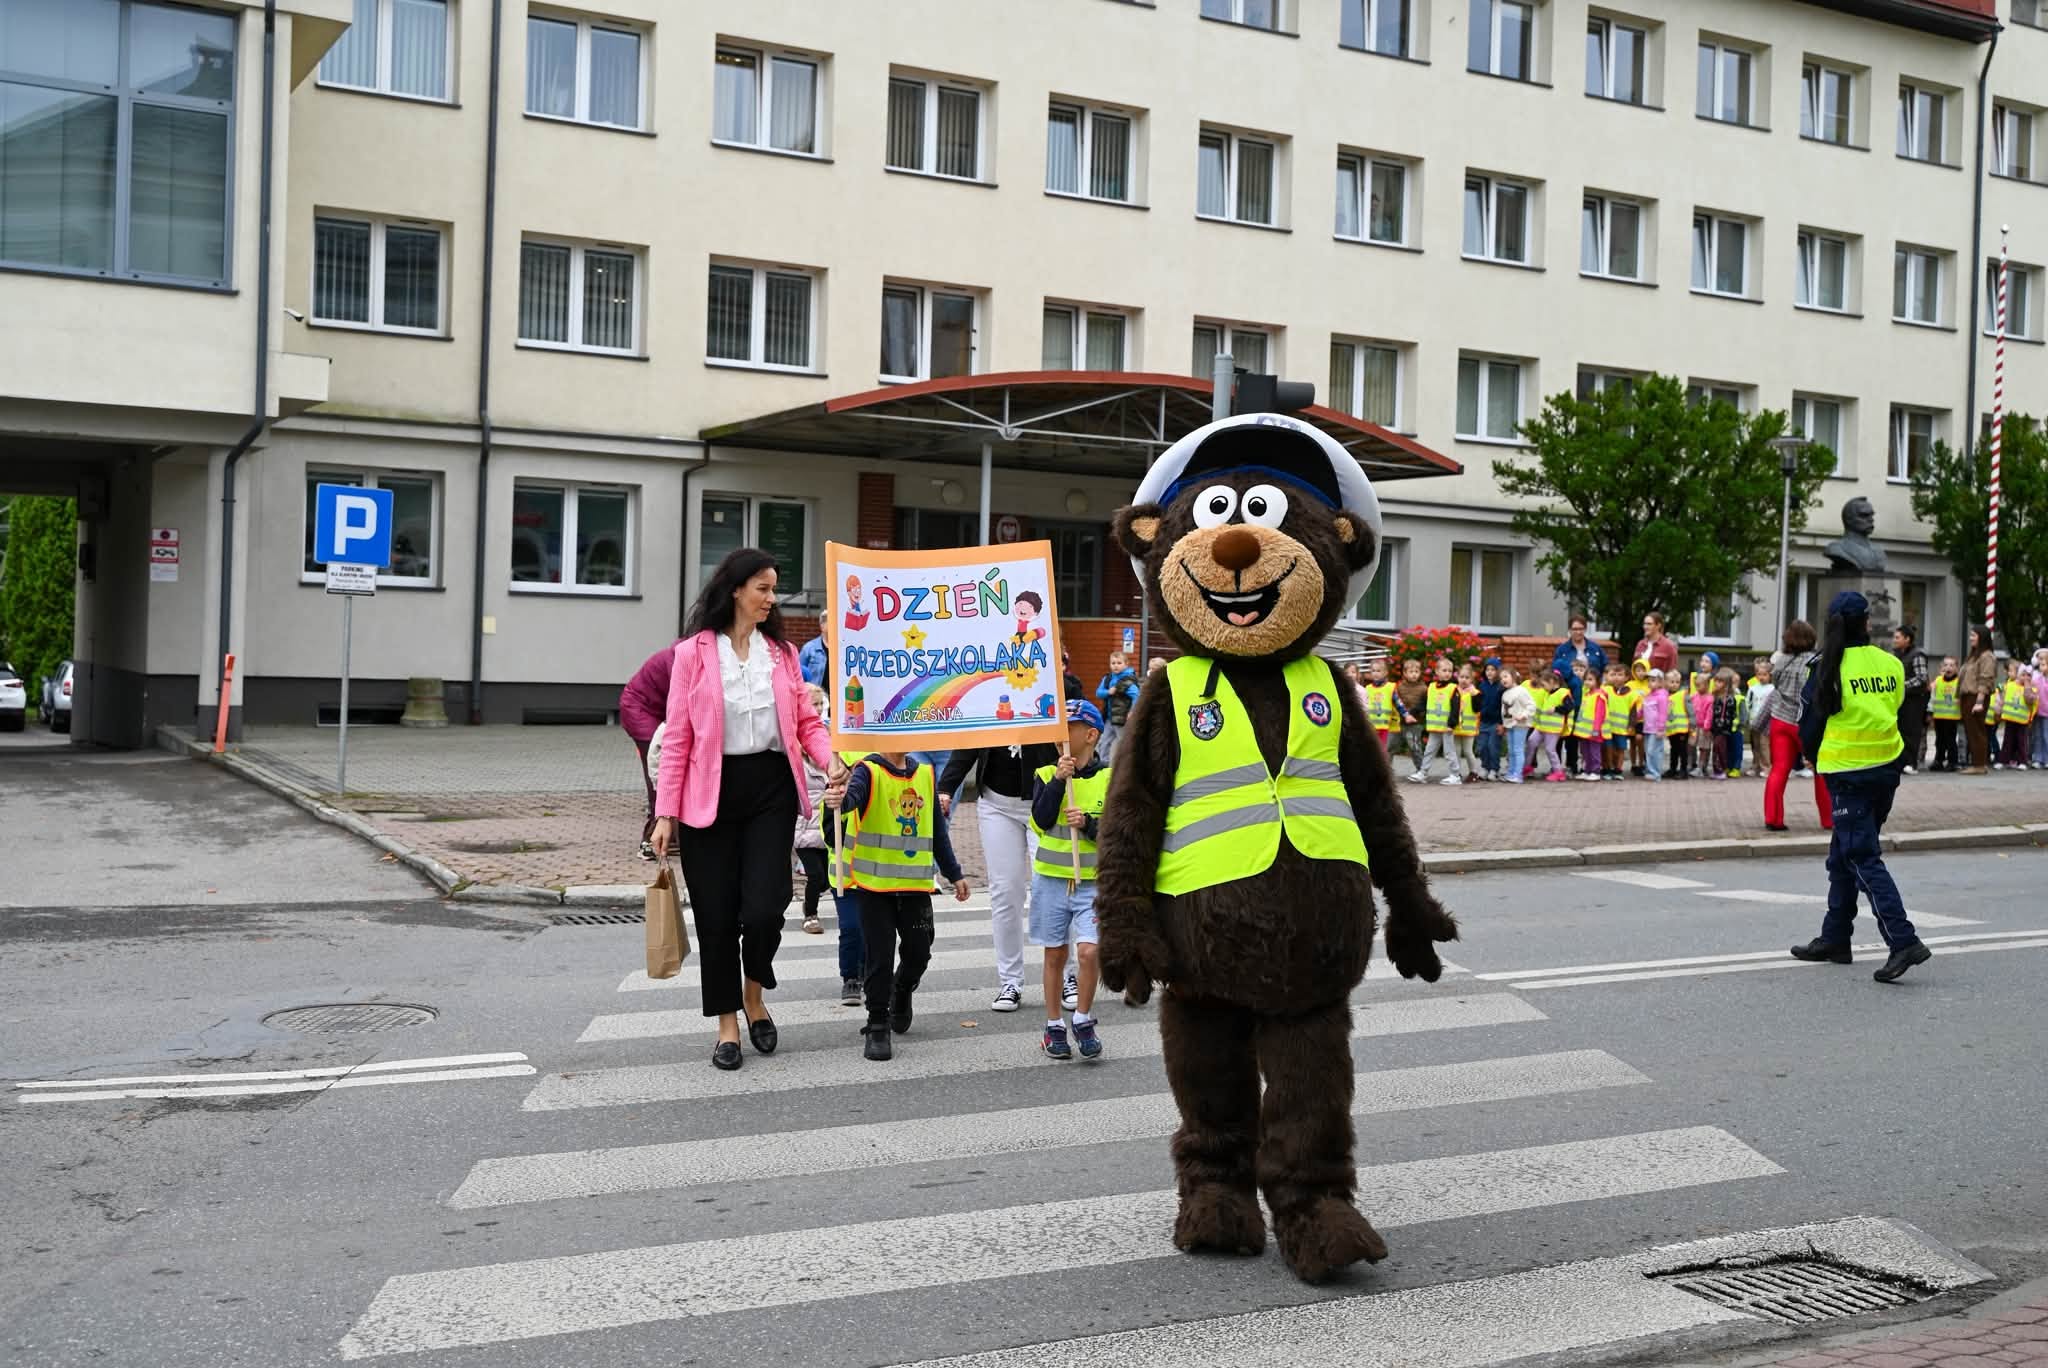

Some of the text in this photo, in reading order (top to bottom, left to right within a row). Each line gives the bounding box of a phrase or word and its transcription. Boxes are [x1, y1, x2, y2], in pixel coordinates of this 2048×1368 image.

[334, 494, 377, 556] P
[873, 567, 1009, 621] DZIEŃ
[845, 639, 1047, 679] PRZEDSZKOLAKA
[1849, 675, 1897, 695] POLICJA
[889, 703, 964, 723] WRZEŚNIA
[1191, 702, 1218, 713] POLICJA
